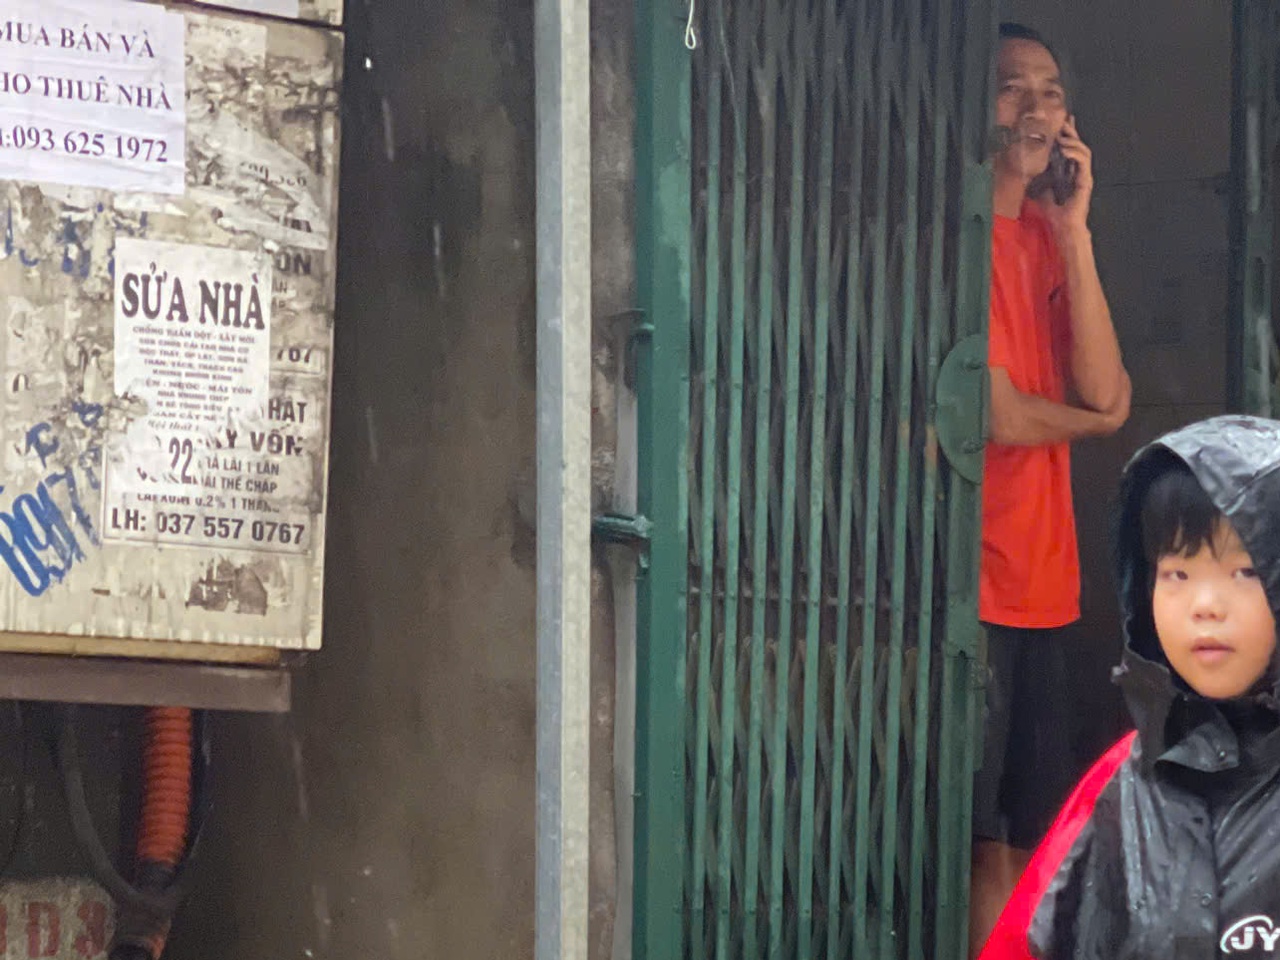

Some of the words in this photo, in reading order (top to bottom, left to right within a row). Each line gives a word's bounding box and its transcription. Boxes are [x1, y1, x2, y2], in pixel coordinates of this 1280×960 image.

[60, 23, 112, 53] BÁN
[120, 29, 155, 58] VÀ
[0, 72, 31, 95] HO
[38, 75, 109, 104] THUÊ
[117, 82, 172, 111] NHÀ
[0, 125, 55, 152] :093
[63, 131, 105, 156] 625
[115, 135, 168, 163] 1972
[121, 261, 189, 323] SỬA
[199, 272, 265, 330] NHÀ
[111, 507, 146, 532] LH:
[156, 511, 195, 535] 037
[203, 516, 244, 539] 557
[252, 520, 305, 545] 0767
